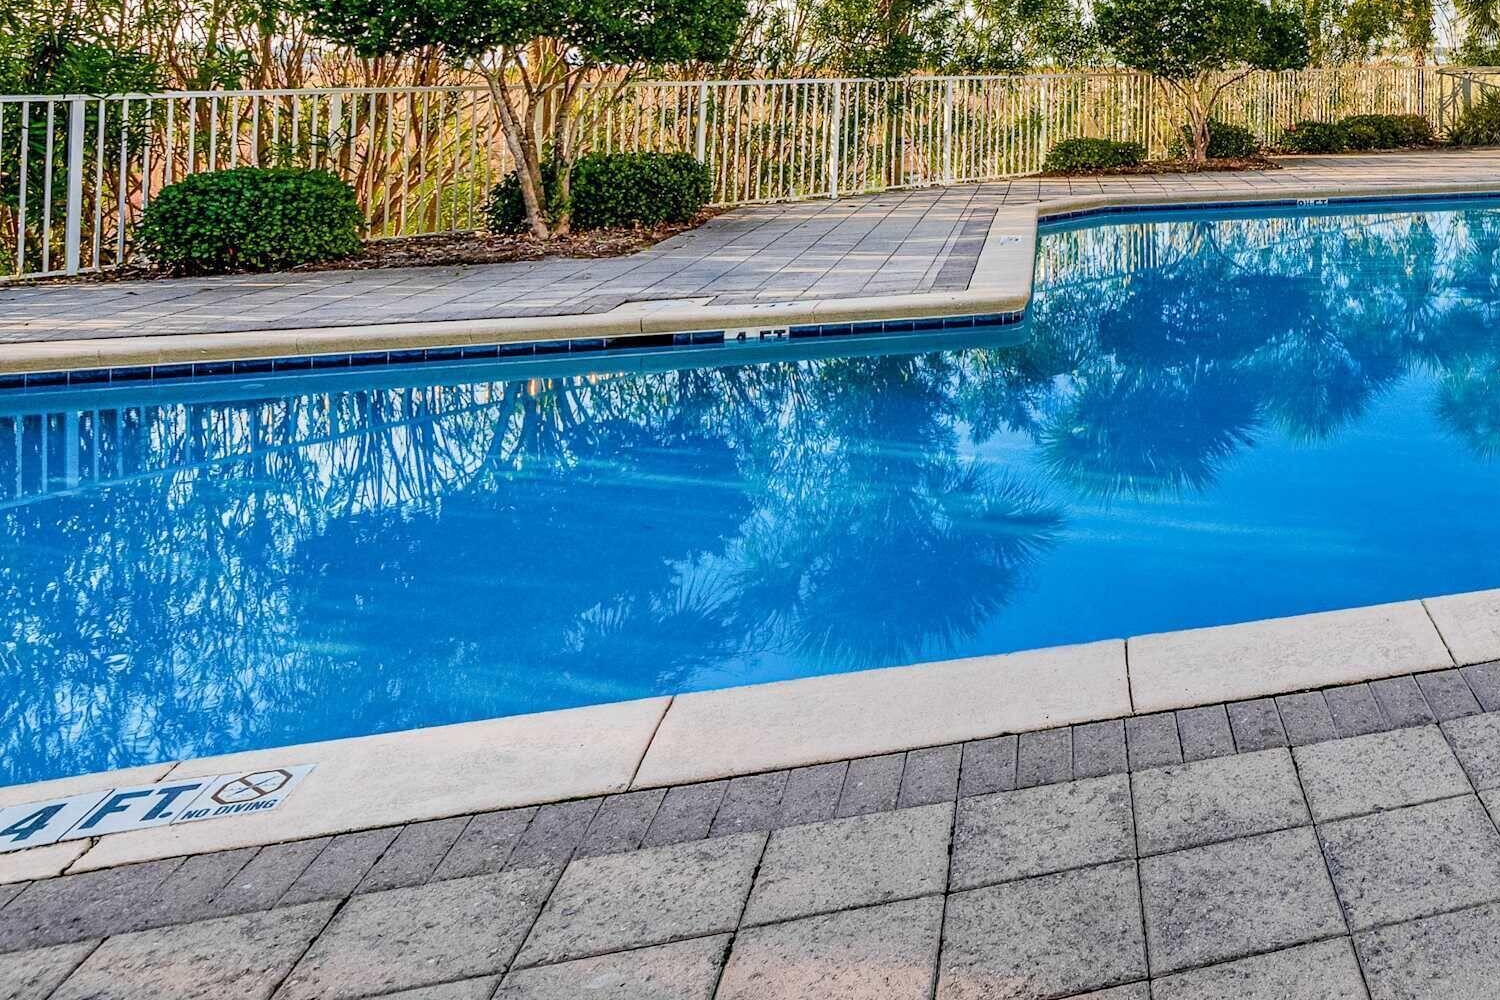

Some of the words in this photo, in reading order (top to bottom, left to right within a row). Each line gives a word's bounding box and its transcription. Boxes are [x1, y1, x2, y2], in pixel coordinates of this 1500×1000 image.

[0, 802, 68, 842] 4
[77, 783, 203, 830] FT.
[181, 808, 211, 820] NO
[212, 799, 278, 816] DIVING
